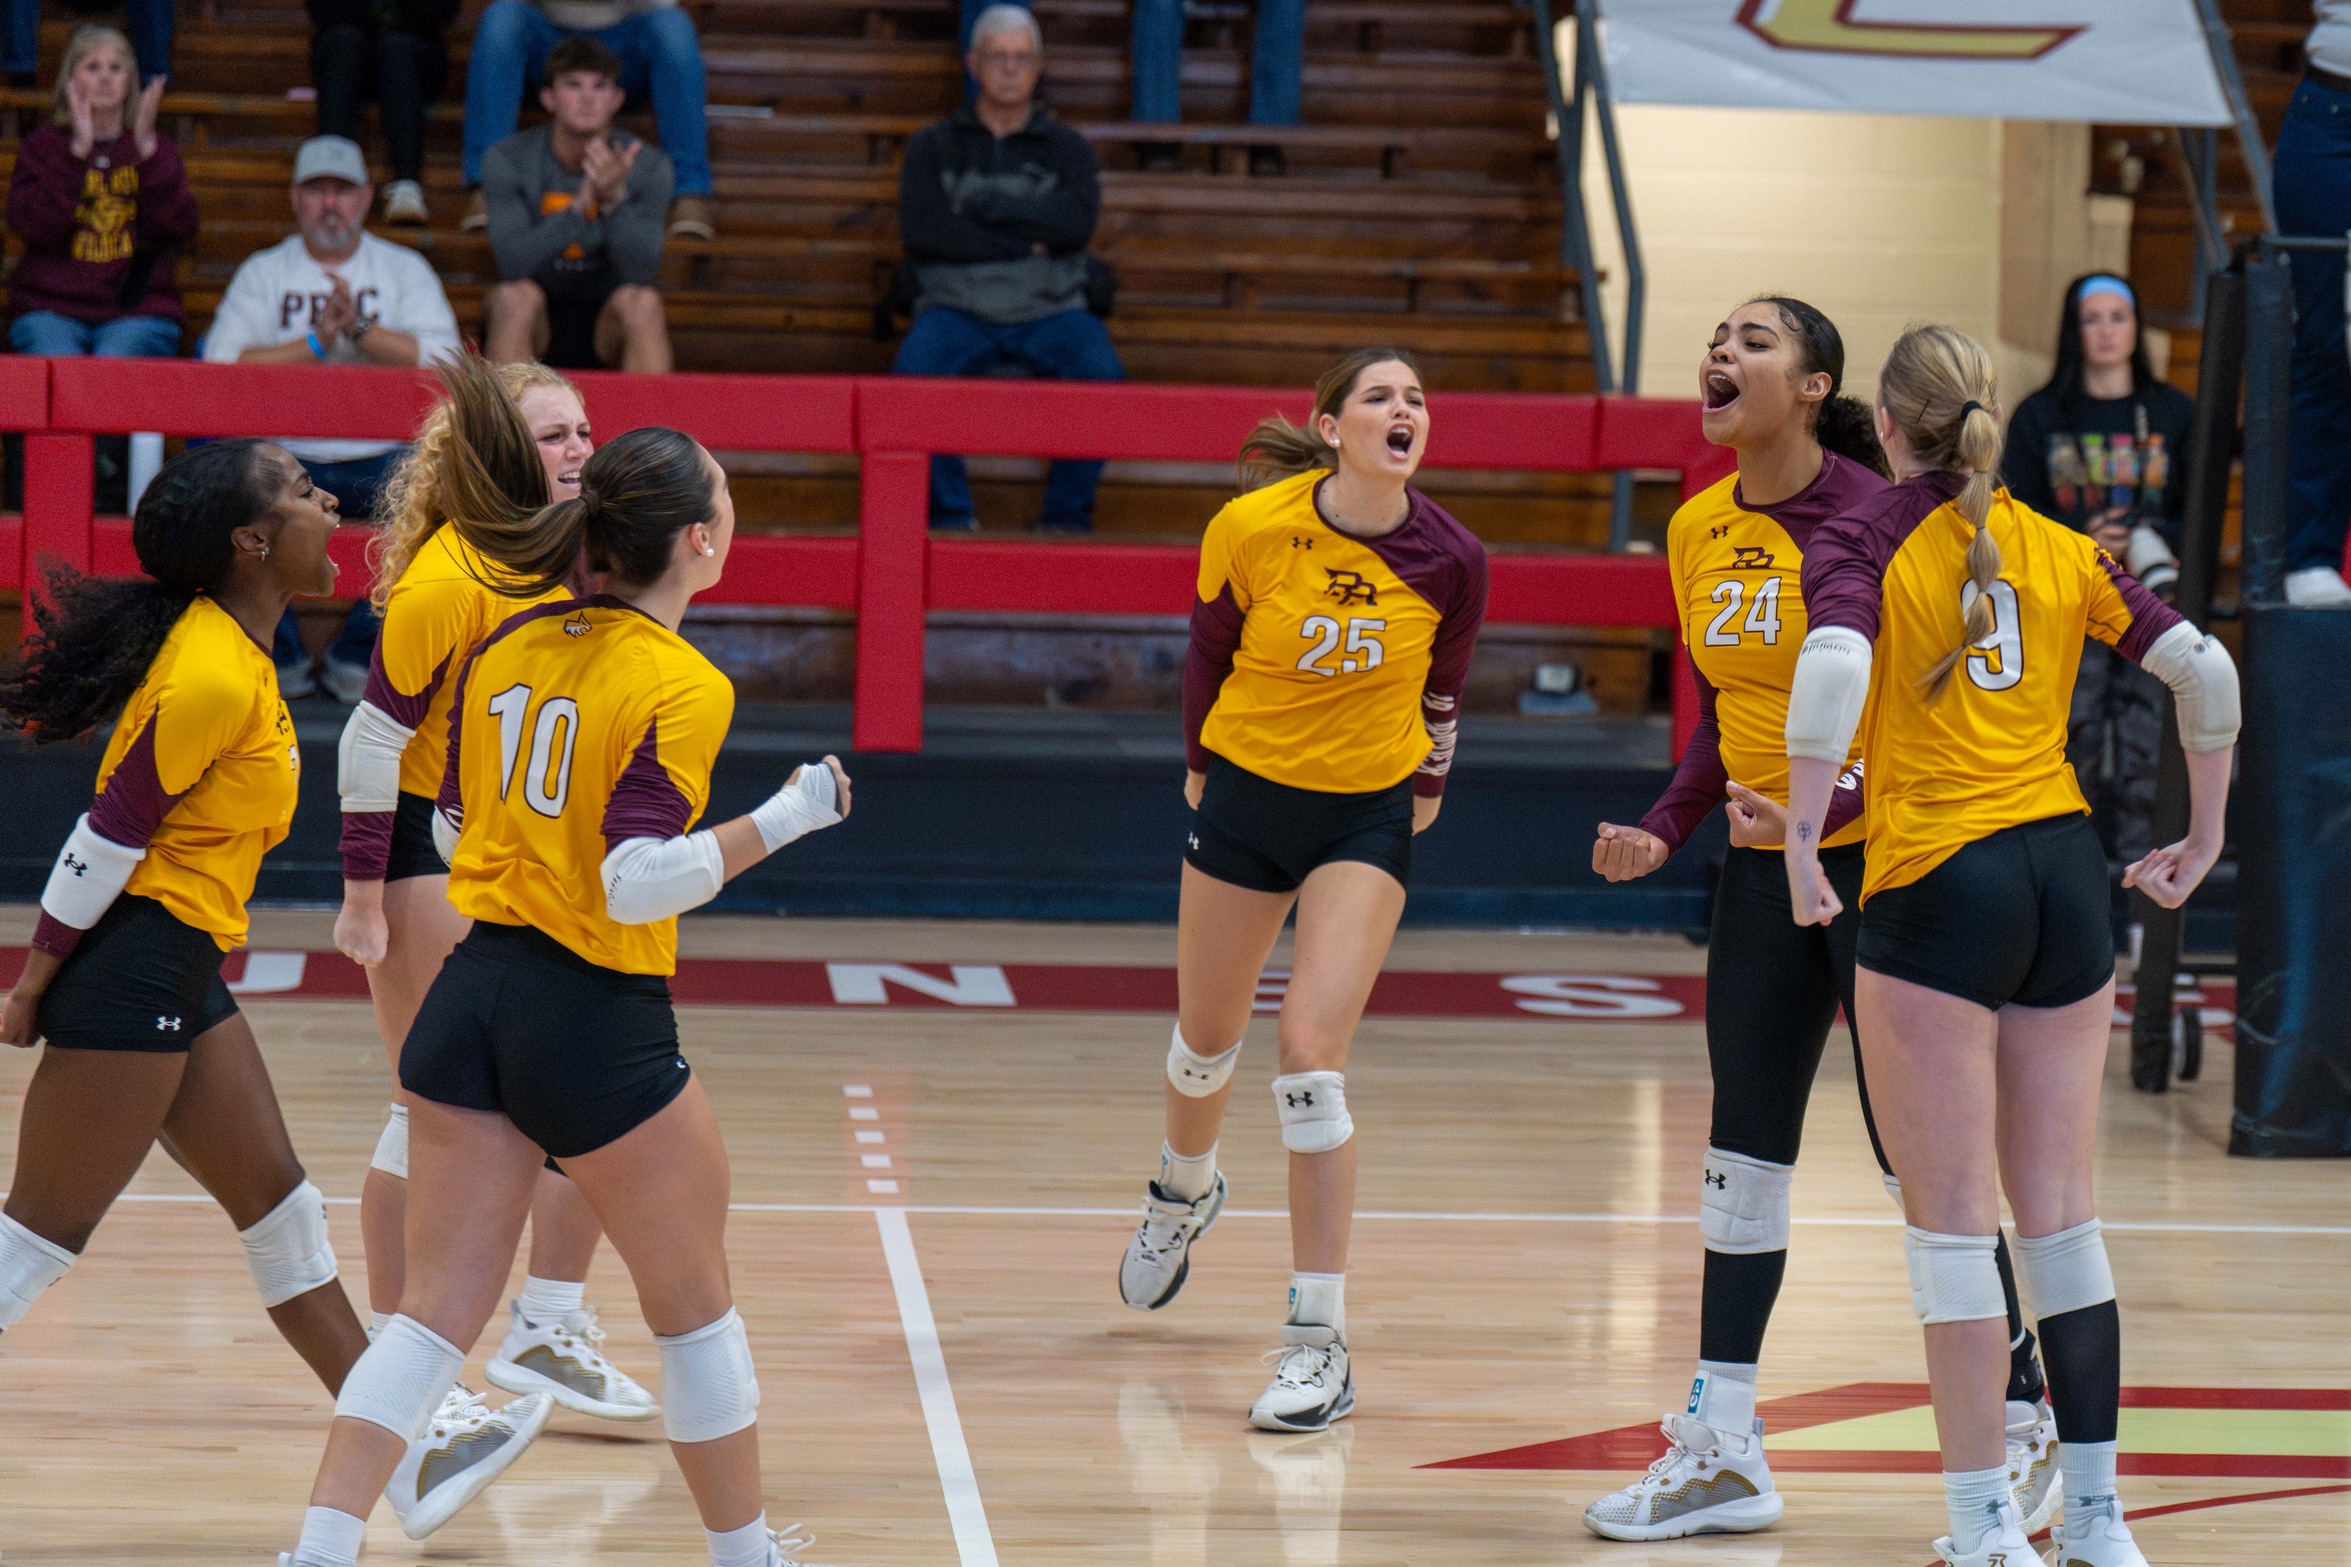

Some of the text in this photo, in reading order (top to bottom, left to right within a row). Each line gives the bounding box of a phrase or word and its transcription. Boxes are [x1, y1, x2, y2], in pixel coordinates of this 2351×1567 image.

[1295, 614, 1388, 678] 25
[1704, 575, 1783, 648] 24
[1960, 578, 2025, 692] 9
[487, 681, 580, 820] 10
